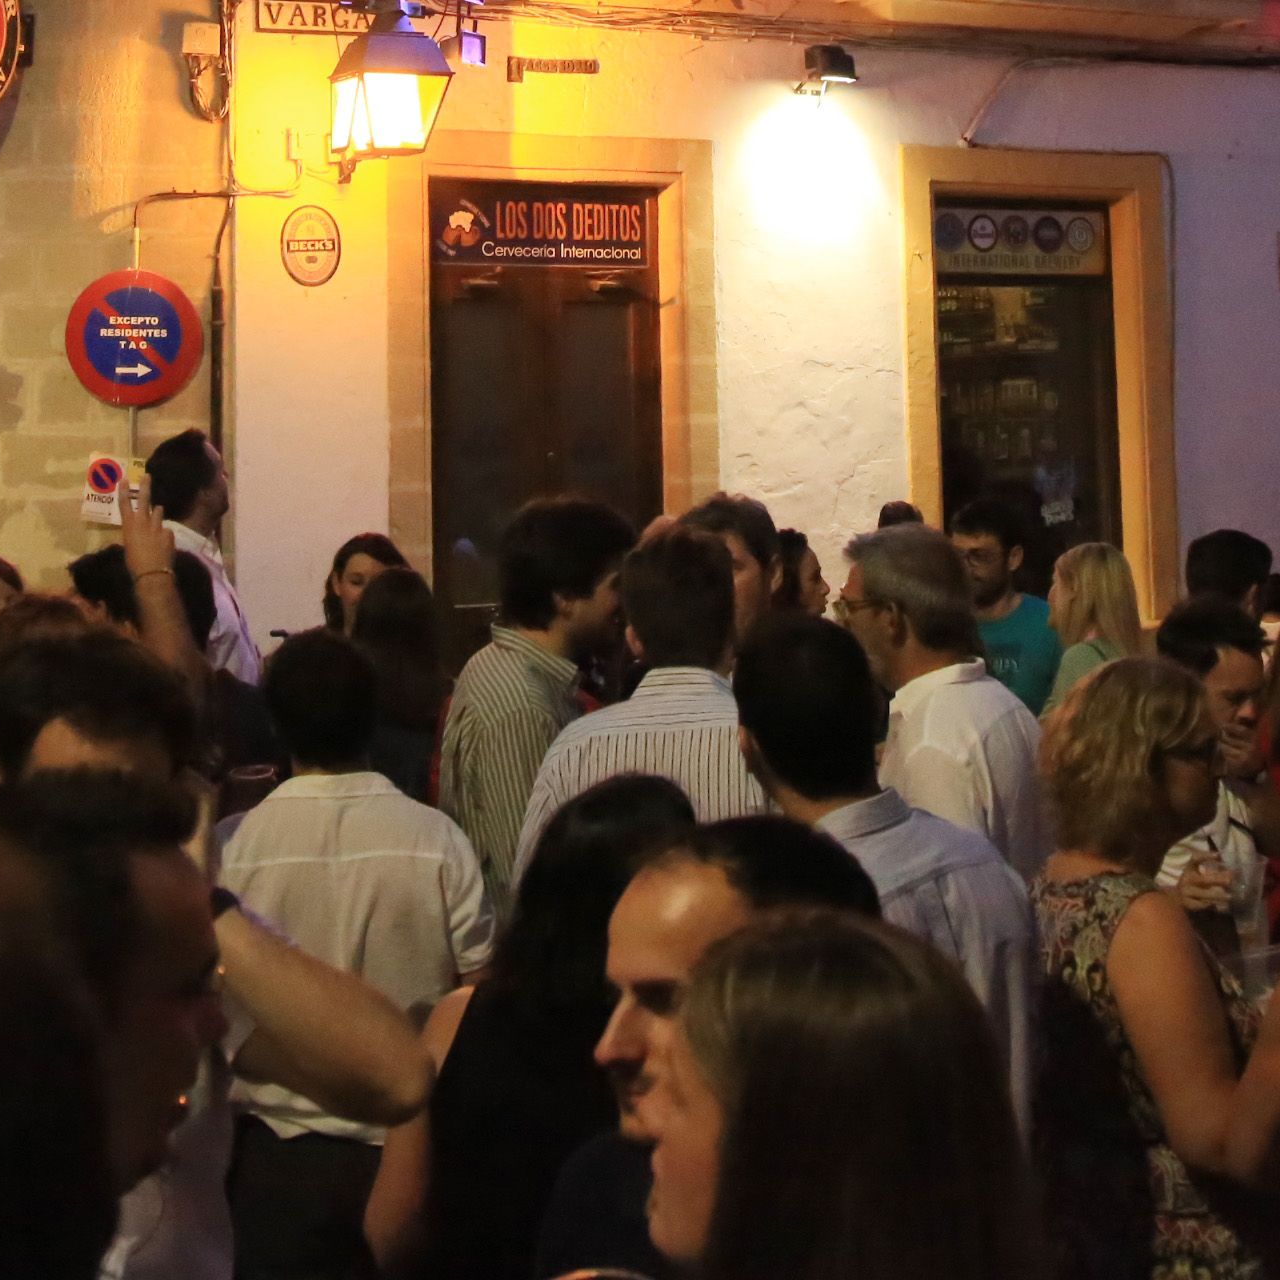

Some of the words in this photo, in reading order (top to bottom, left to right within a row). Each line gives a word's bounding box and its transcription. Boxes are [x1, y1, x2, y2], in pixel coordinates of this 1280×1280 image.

[495, 201, 528, 240] LOS
[532, 201, 567, 240] DOS
[572, 203, 641, 242] DEDITOS
[481, 241, 556, 258] Cervecería
[560, 243, 642, 260] Internacional
[109, 316, 159, 325] EXCEPTO
[99, 328, 168, 337] RESIDENTES
